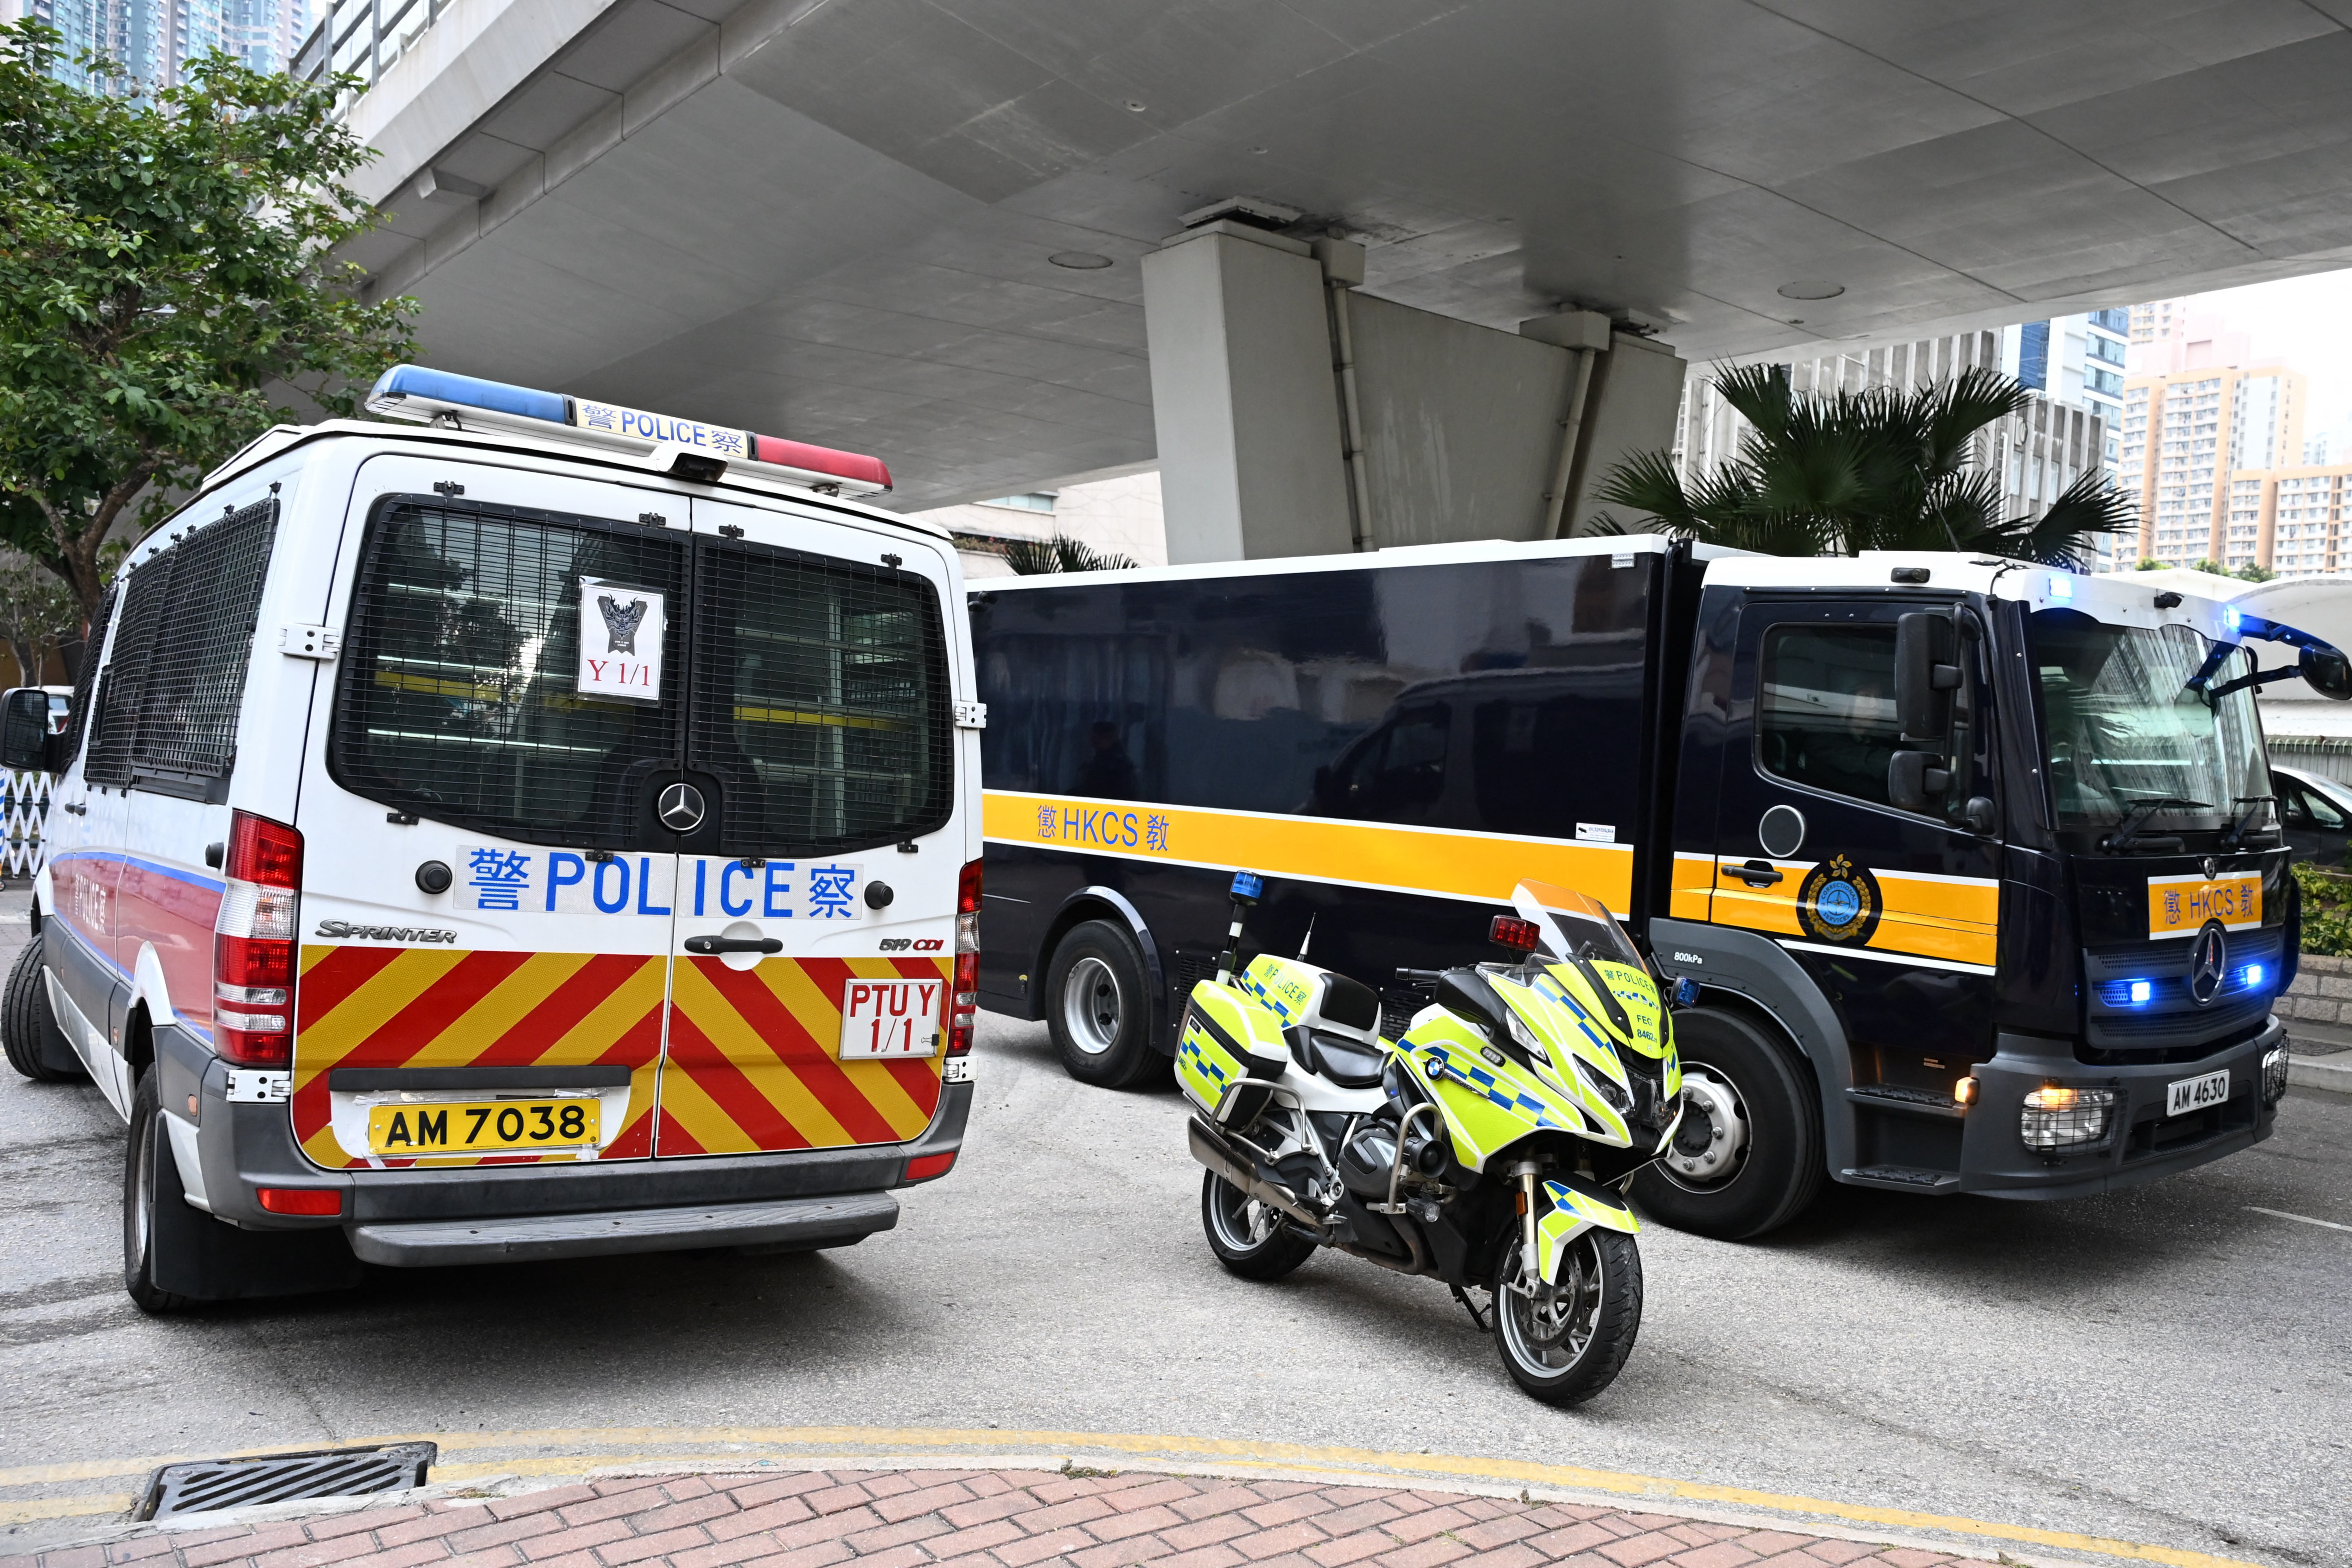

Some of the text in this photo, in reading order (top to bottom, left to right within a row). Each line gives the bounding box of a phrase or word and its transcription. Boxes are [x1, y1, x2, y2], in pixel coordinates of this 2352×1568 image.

[582, 404, 743, 454] 警 POLICE 察
[587, 659, 650, 686] Y 1/1
[1037, 804, 1057, 838] 懲
[1064, 808, 1138, 847] HKCS
[468, 848, 855, 918] 警 POLICE 察
[1822, 882, 1857, 901] CORRECTIONAL
[79, 875, 99, 930] POLICE
[1823, 912, 1850, 923] SERVICES
[2164, 889, 2181, 924] 懲
[2190, 889, 2234, 919] HKCS
[315, 919, 457, 943] SPRINTER
[879, 939, 944, 950] 519 CDI
[1674, 951, 1702, 964] 800kPa
[1269, 969, 1300, 999] POLICE
[1616, 970, 1651, 991] POLICE
[850, 985, 936, 1017] PTU Y
[871, 1018, 912, 1052] 1/1
[1637, 1014, 1652, 1026] FEG
[2173, 1077, 2225, 1110] AM 4630
[384, 1105, 585, 1147] AM 7038
